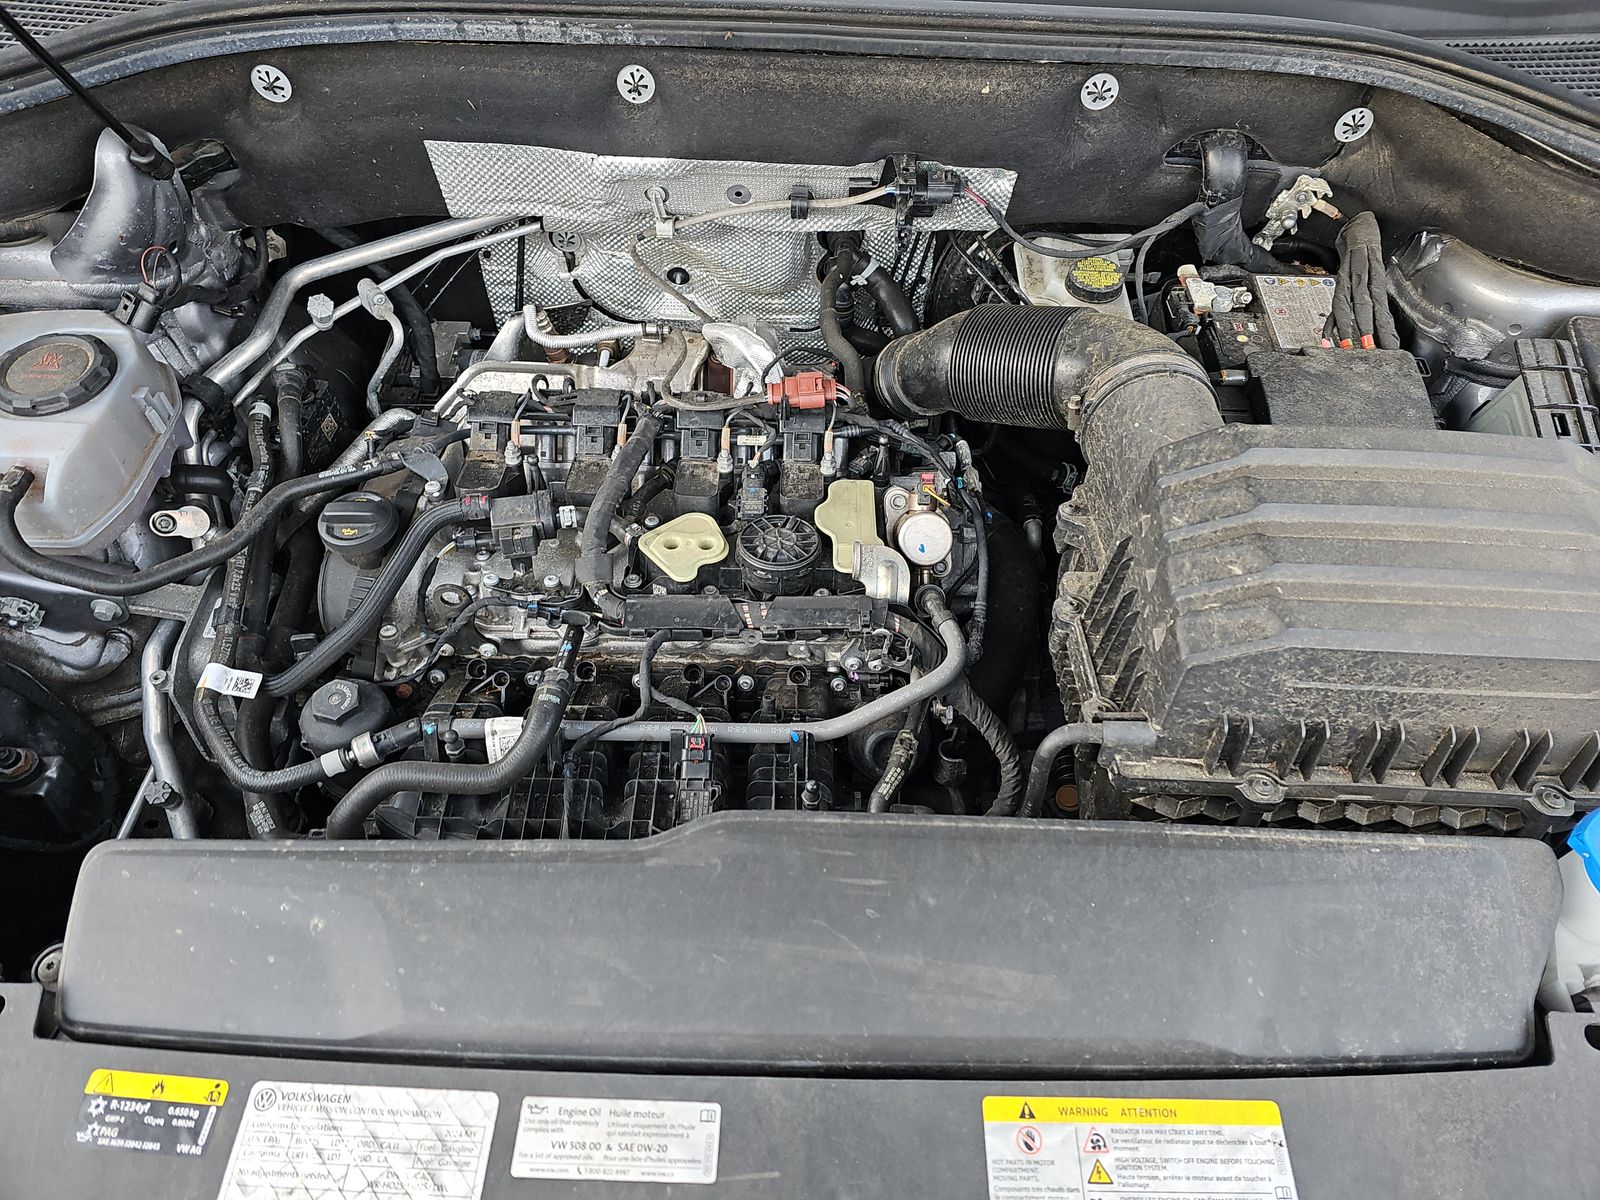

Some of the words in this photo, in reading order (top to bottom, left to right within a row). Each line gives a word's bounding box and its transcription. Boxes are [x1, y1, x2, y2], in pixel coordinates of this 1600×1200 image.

[281, 1091, 352, 1104] VOLKSWAGEN
[558, 1107, 587, 1119] Engine
[589, 1108, 601, 1116] Oil
[609, 1109, 632, 1118] Huile
[1058, 1107, 1108, 1117] WARNING
[1121, 1108, 1177, 1118] ATTENTION
[100, 1126, 119, 1137] PAG
[189, 1145, 202, 1155] AG
[441, 1144, 475, 1154] Gasoline
[551, 1140, 568, 1150] VW
[570, 1141, 587, 1150] 508
[589, 1142, 601, 1151] 00
[618, 1143, 635, 1152] SAE
[637, 1144, 668, 1153] 0W-20
[438, 1158, 471, 1169] Gasoline
